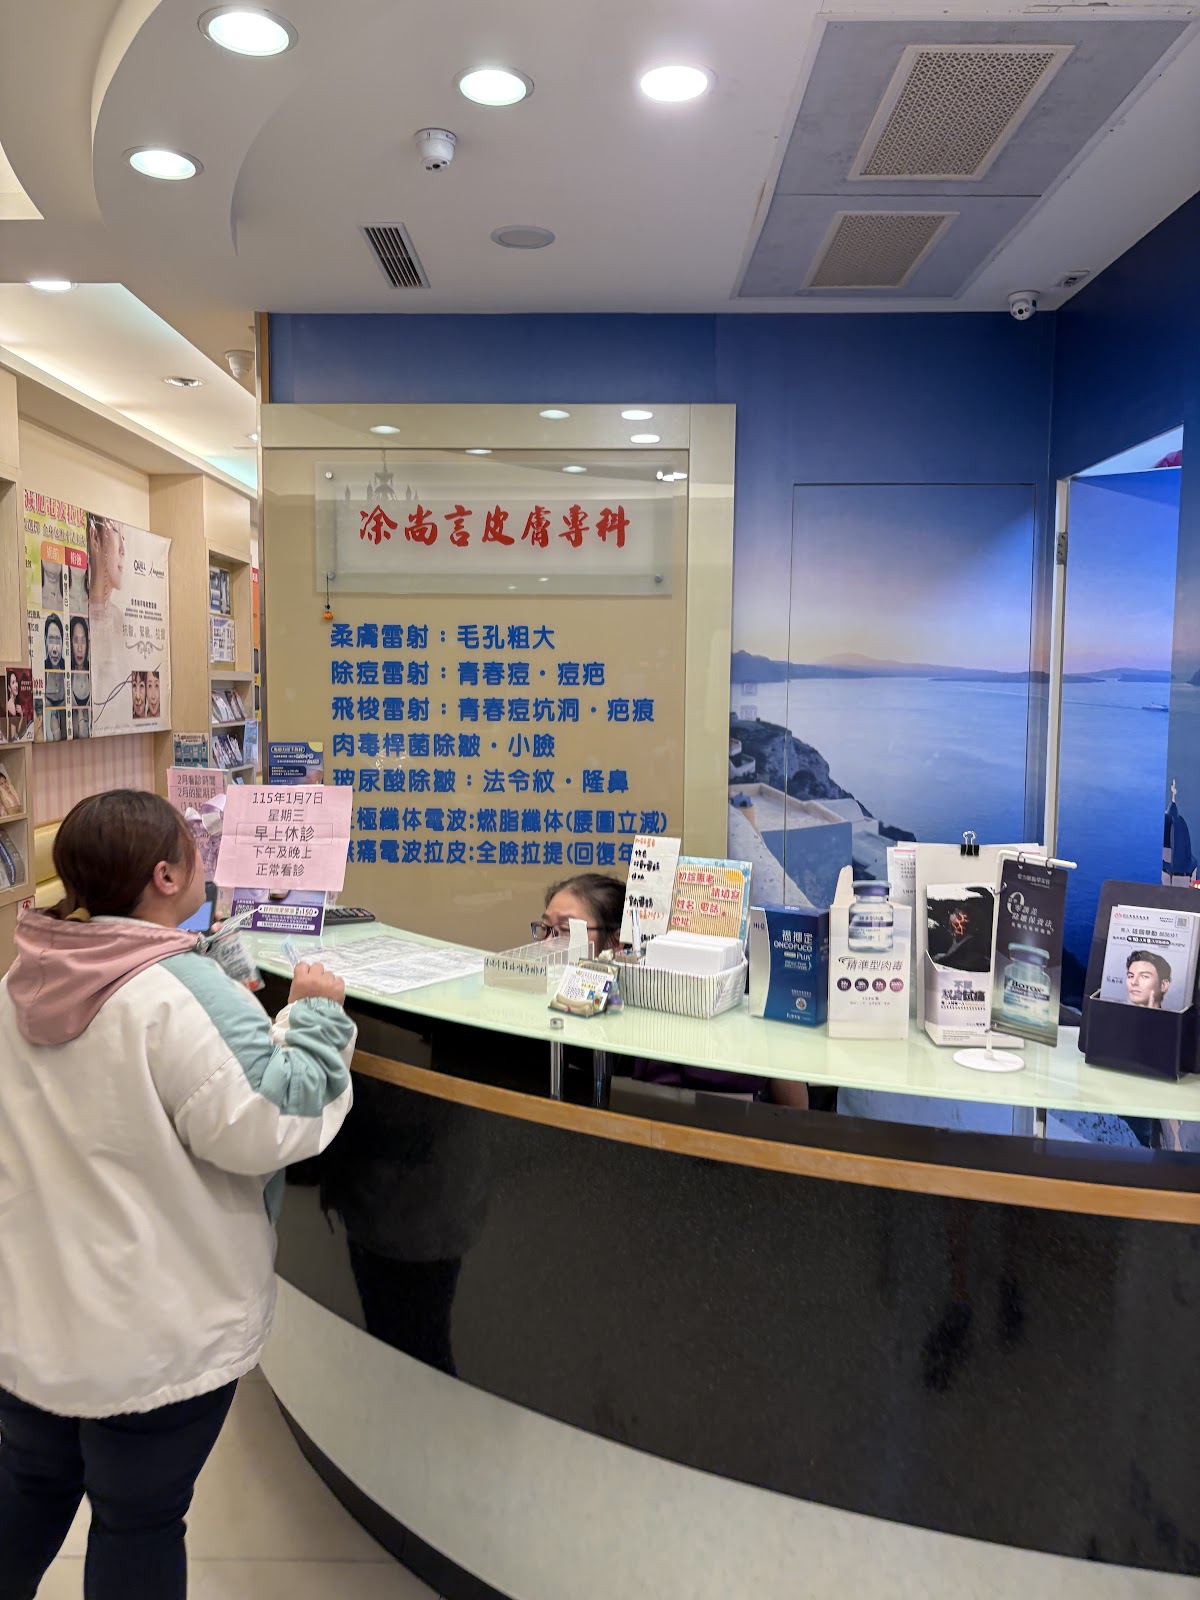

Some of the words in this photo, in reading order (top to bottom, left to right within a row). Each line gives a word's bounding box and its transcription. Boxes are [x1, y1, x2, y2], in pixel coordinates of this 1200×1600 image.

[253, 792, 323, 805] 115年1月7日
[268, 809, 304, 822] 星期三
[255, 825, 315, 842] 早上休診
[253, 845, 312, 859] 下午及晚上
[256, 863, 305, 877] 正常看診
[700, 901, 719, 914] 電話
